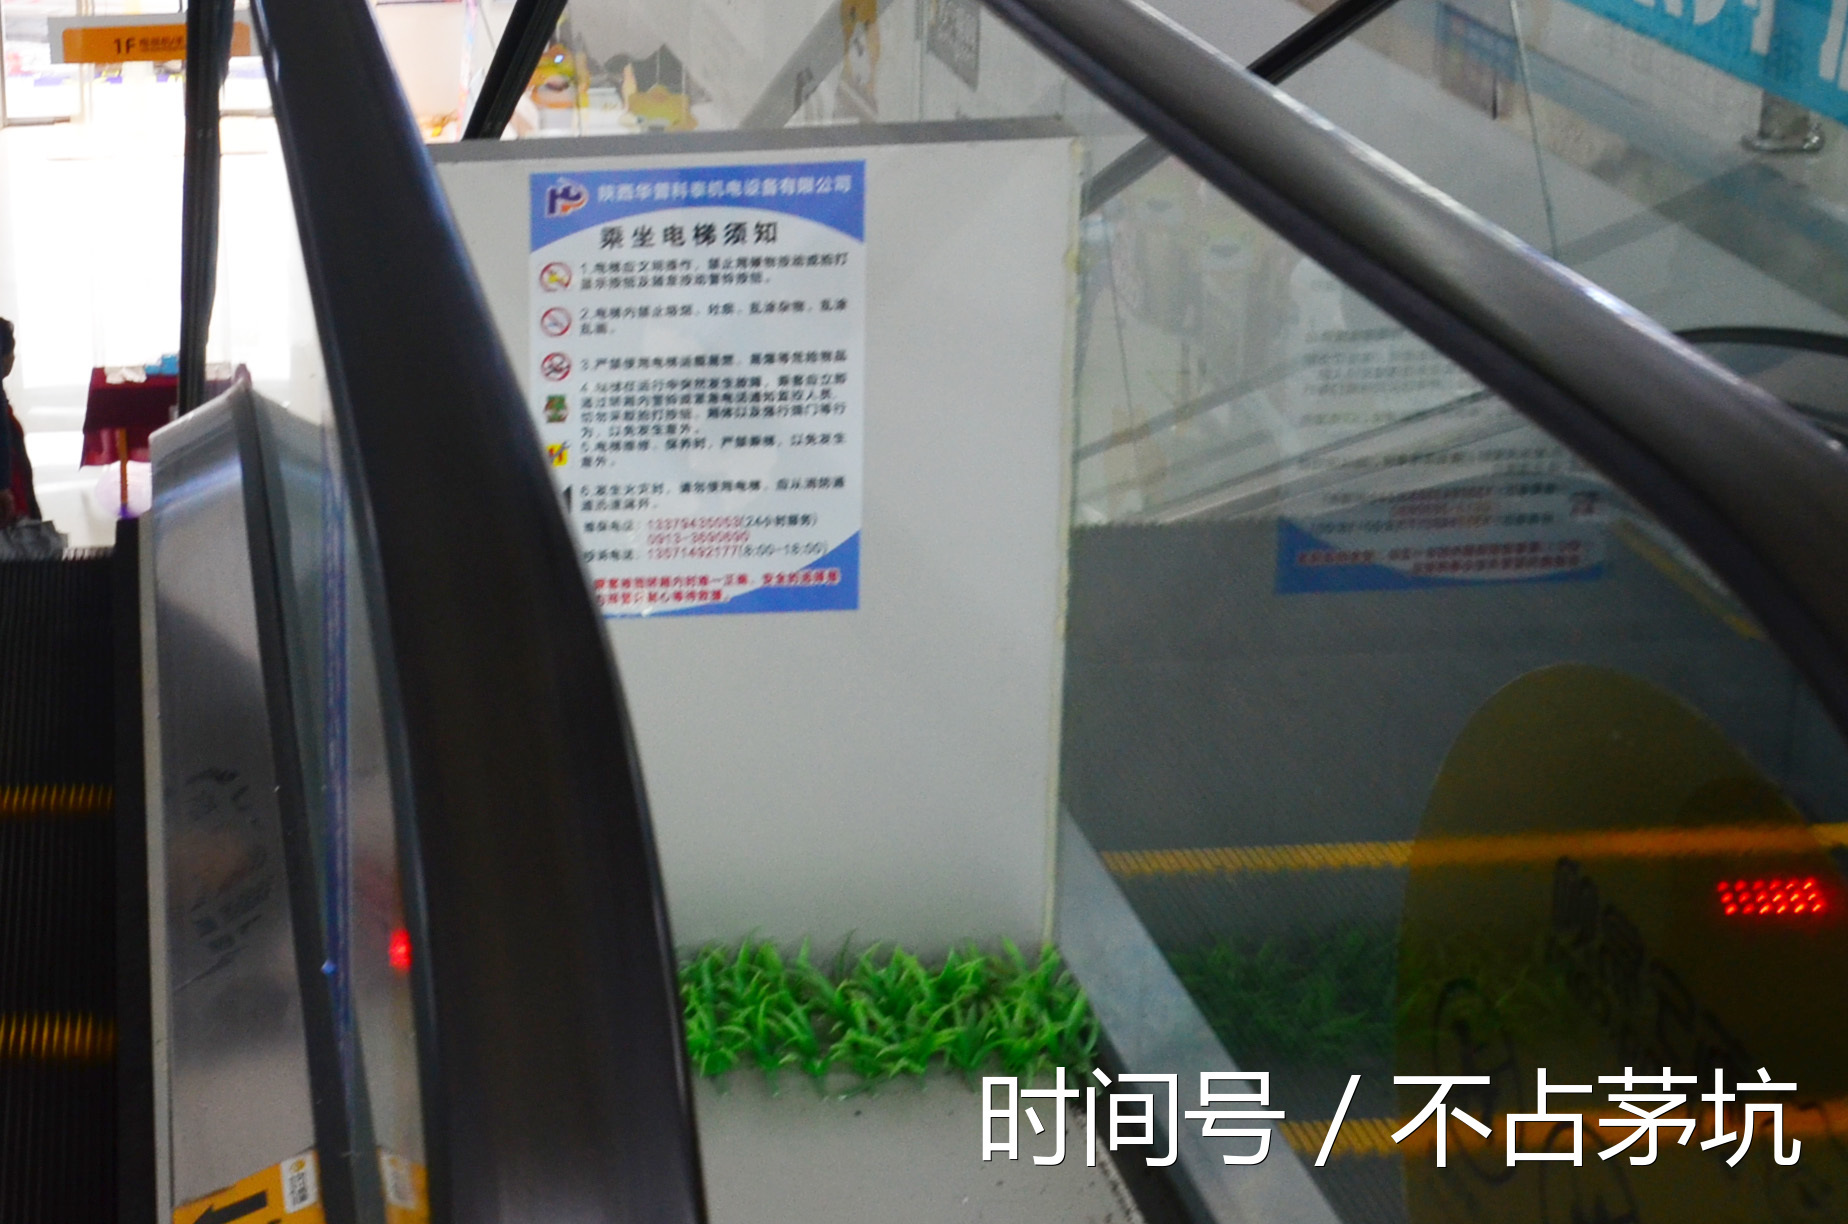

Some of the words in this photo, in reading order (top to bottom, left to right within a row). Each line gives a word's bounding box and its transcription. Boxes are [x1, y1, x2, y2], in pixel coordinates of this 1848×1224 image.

[113, 36, 136, 55] 1F
[600, 220, 779, 250] 乘坐电梯须知
